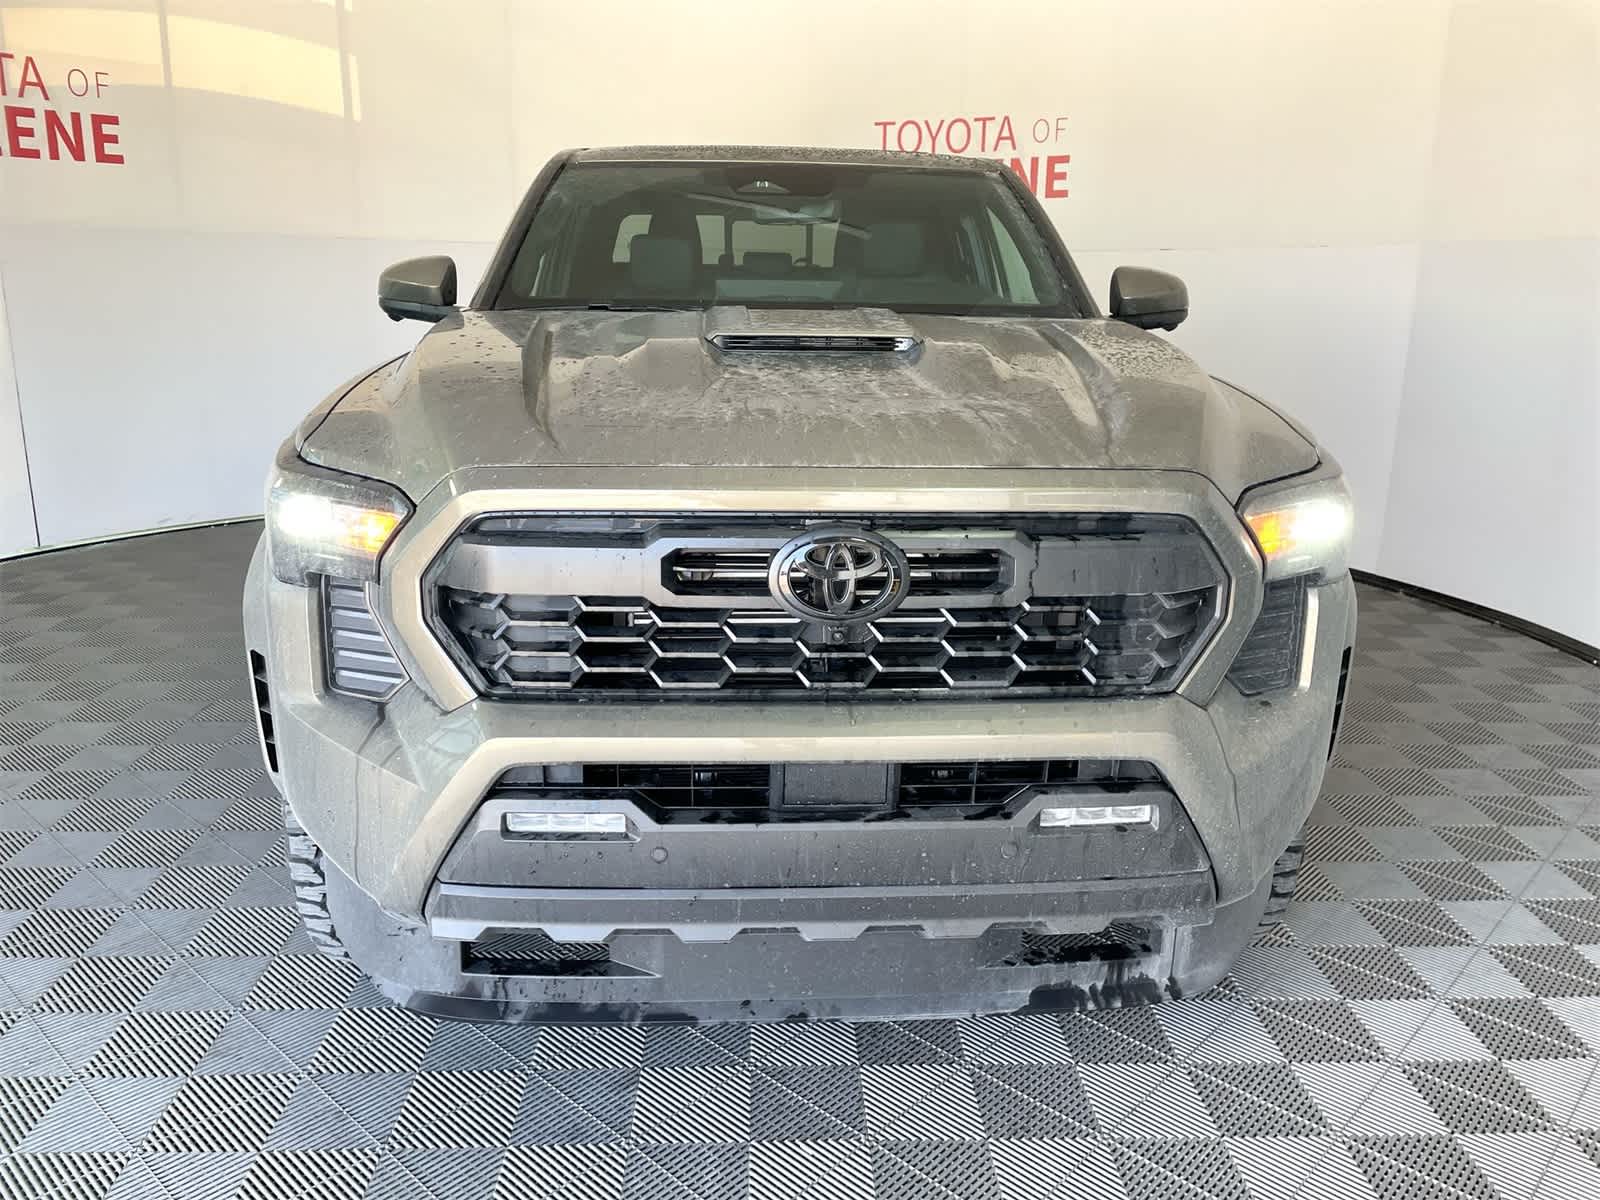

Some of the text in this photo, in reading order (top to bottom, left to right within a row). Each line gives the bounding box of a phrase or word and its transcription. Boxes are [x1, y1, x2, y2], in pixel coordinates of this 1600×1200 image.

[67, 68, 109, 98] OF
[0, 105, 125, 165] ENE
[874, 115, 1069, 154] TOYOTA OF
[992, 155, 1071, 199] NE
